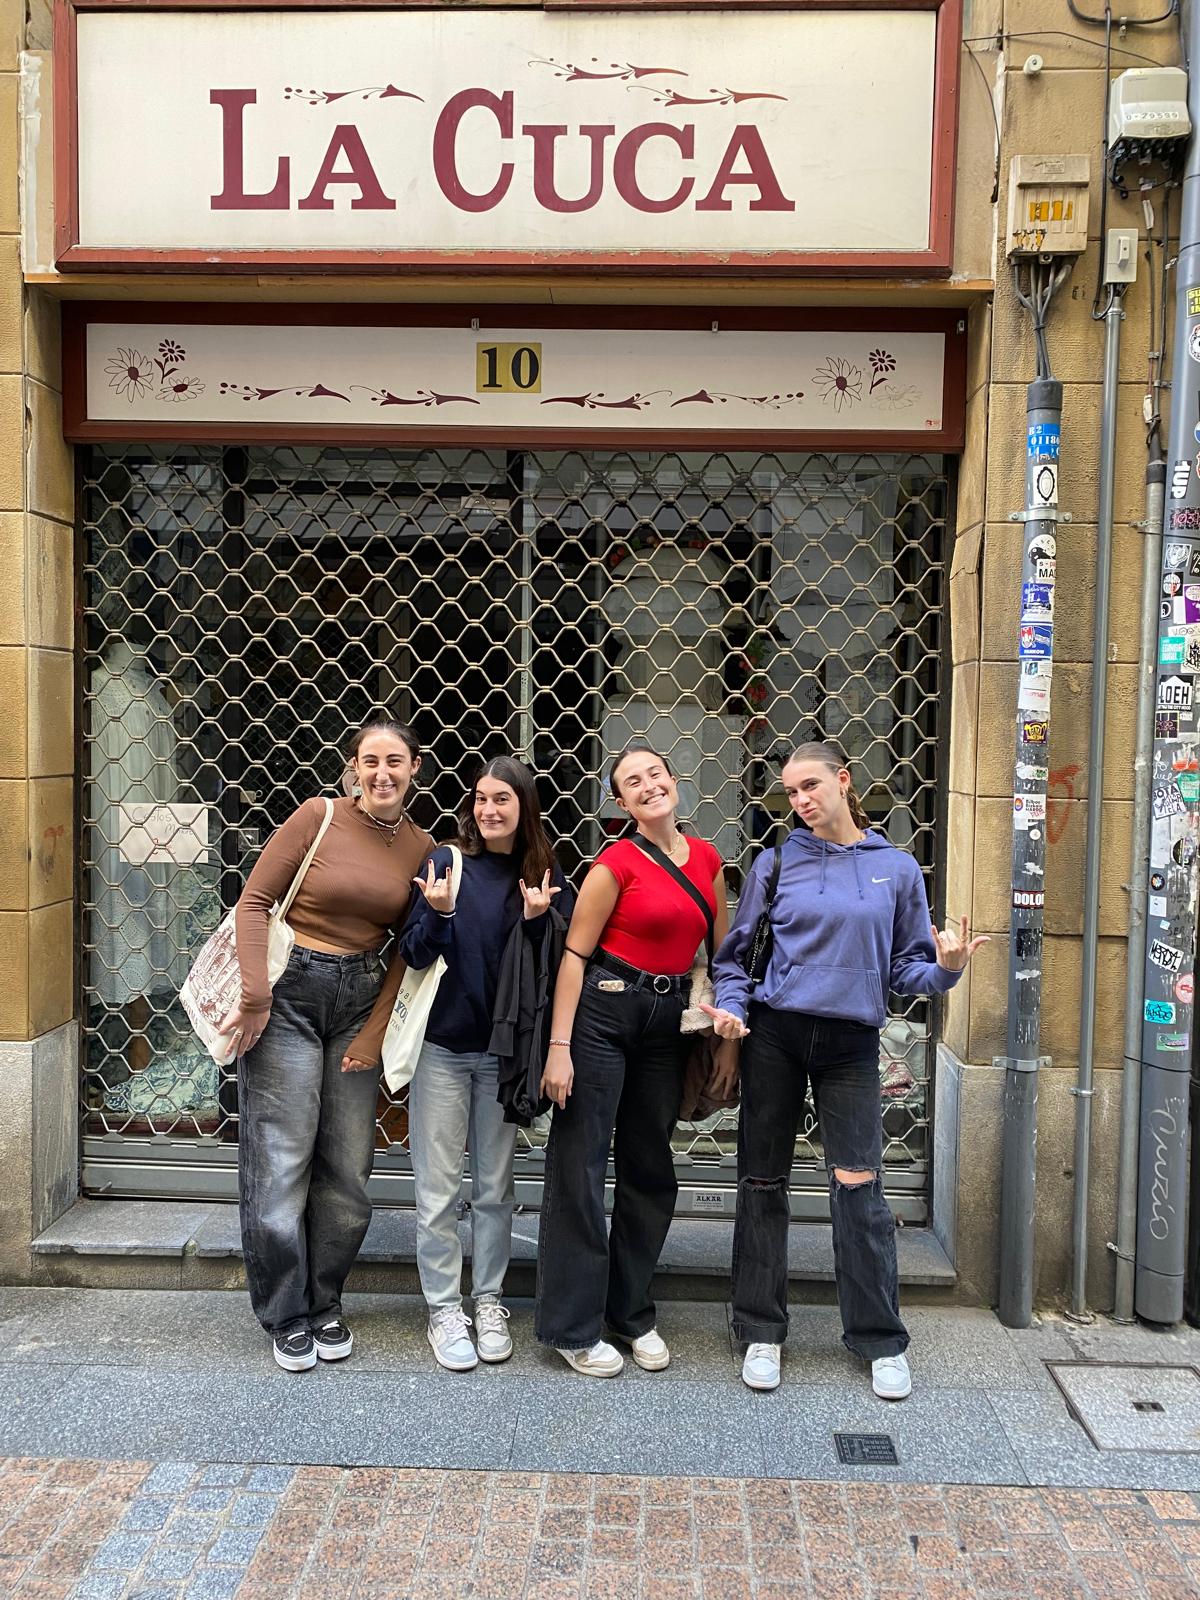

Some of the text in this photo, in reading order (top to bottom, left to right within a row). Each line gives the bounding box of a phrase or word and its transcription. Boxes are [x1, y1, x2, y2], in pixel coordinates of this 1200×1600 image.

[209, 87, 796, 213] LA CUCA
[481, 347, 540, 389] 10
[1171, 460, 1192, 499] 1UP
[1014, 892, 1045, 906] DOLO
